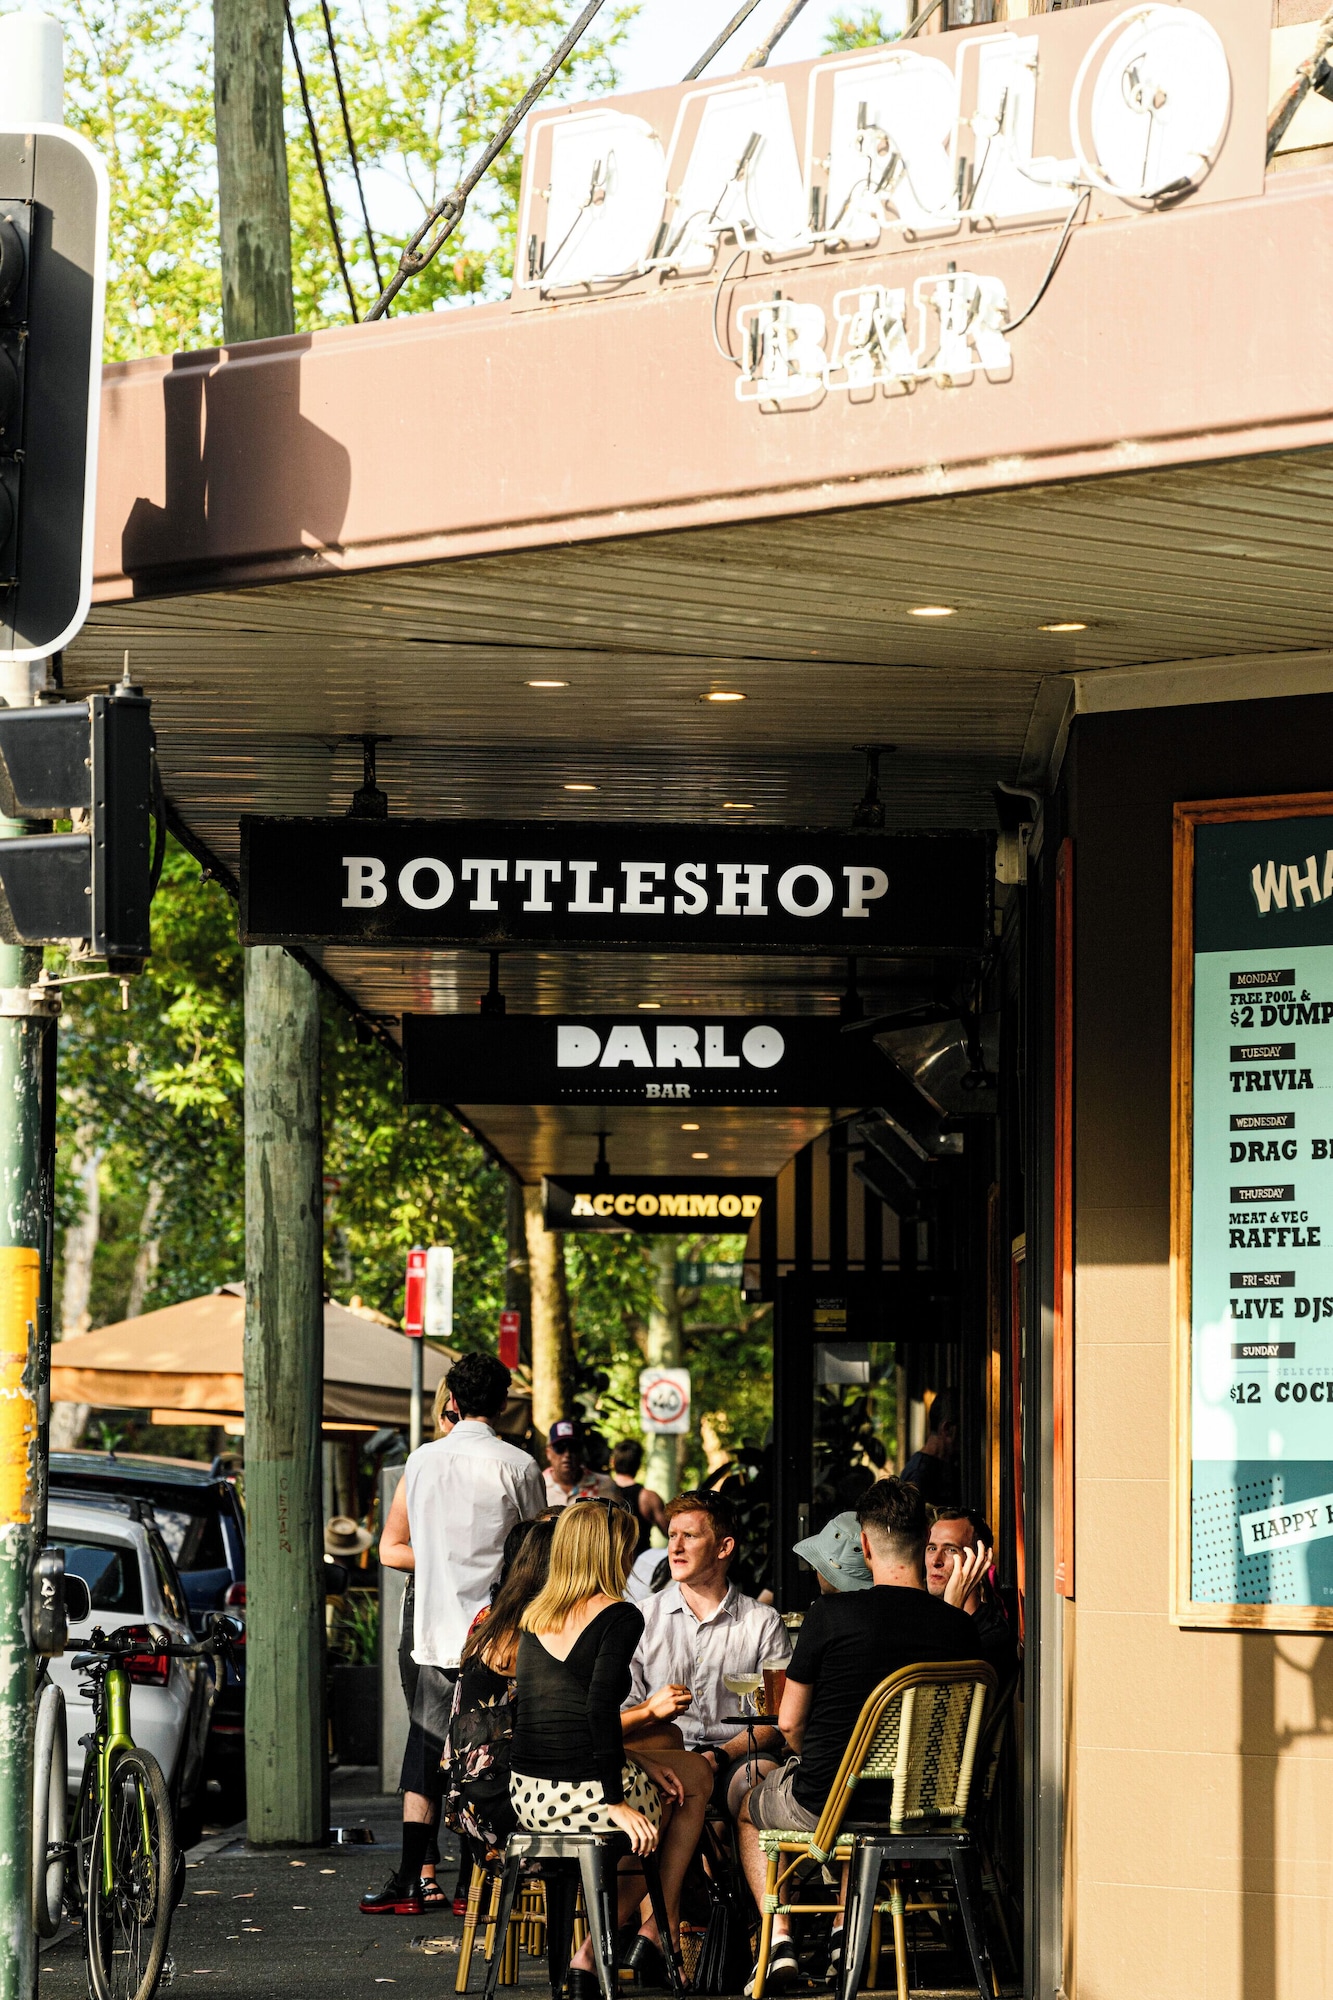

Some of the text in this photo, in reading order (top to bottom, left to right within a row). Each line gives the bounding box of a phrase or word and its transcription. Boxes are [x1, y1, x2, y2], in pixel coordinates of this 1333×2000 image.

[521, 3, 1233, 291] DARLO
[736, 272, 1013, 402] BAR
[341, 856, 890, 918] BOTTLESHOP
[1237, 972, 1281, 985] MONDAY
[1230, 989, 1311, 1005] FREE POOL &
[1230, 1006, 1254, 1028] $2
[557, 1025, 785, 1069] DARLO
[1240, 1046, 1281, 1059] TUESDAY
[645, 1083, 691, 1098] BAR
[1230, 1069, 1314, 1092] TRIVIA
[1236, 1116, 1288, 1128] WEDNESDAY
[1230, 1138, 1333, 1163] DRAG B
[1239, 1188, 1284, 1200] THURSDAY
[1229, 1211, 1308, 1225] MEAT & VEG
[1229, 1226, 1321, 1249] RAFFLE
[1242, 1274, 1281, 1287] FRI-SAT
[1230, 1298, 1284, 1319] LIVE
[1242, 1345, 1279, 1357] SUNDAY
[1230, 1383, 1262, 1404] $12
[1251, 1508, 1319, 1543] HAPPY
